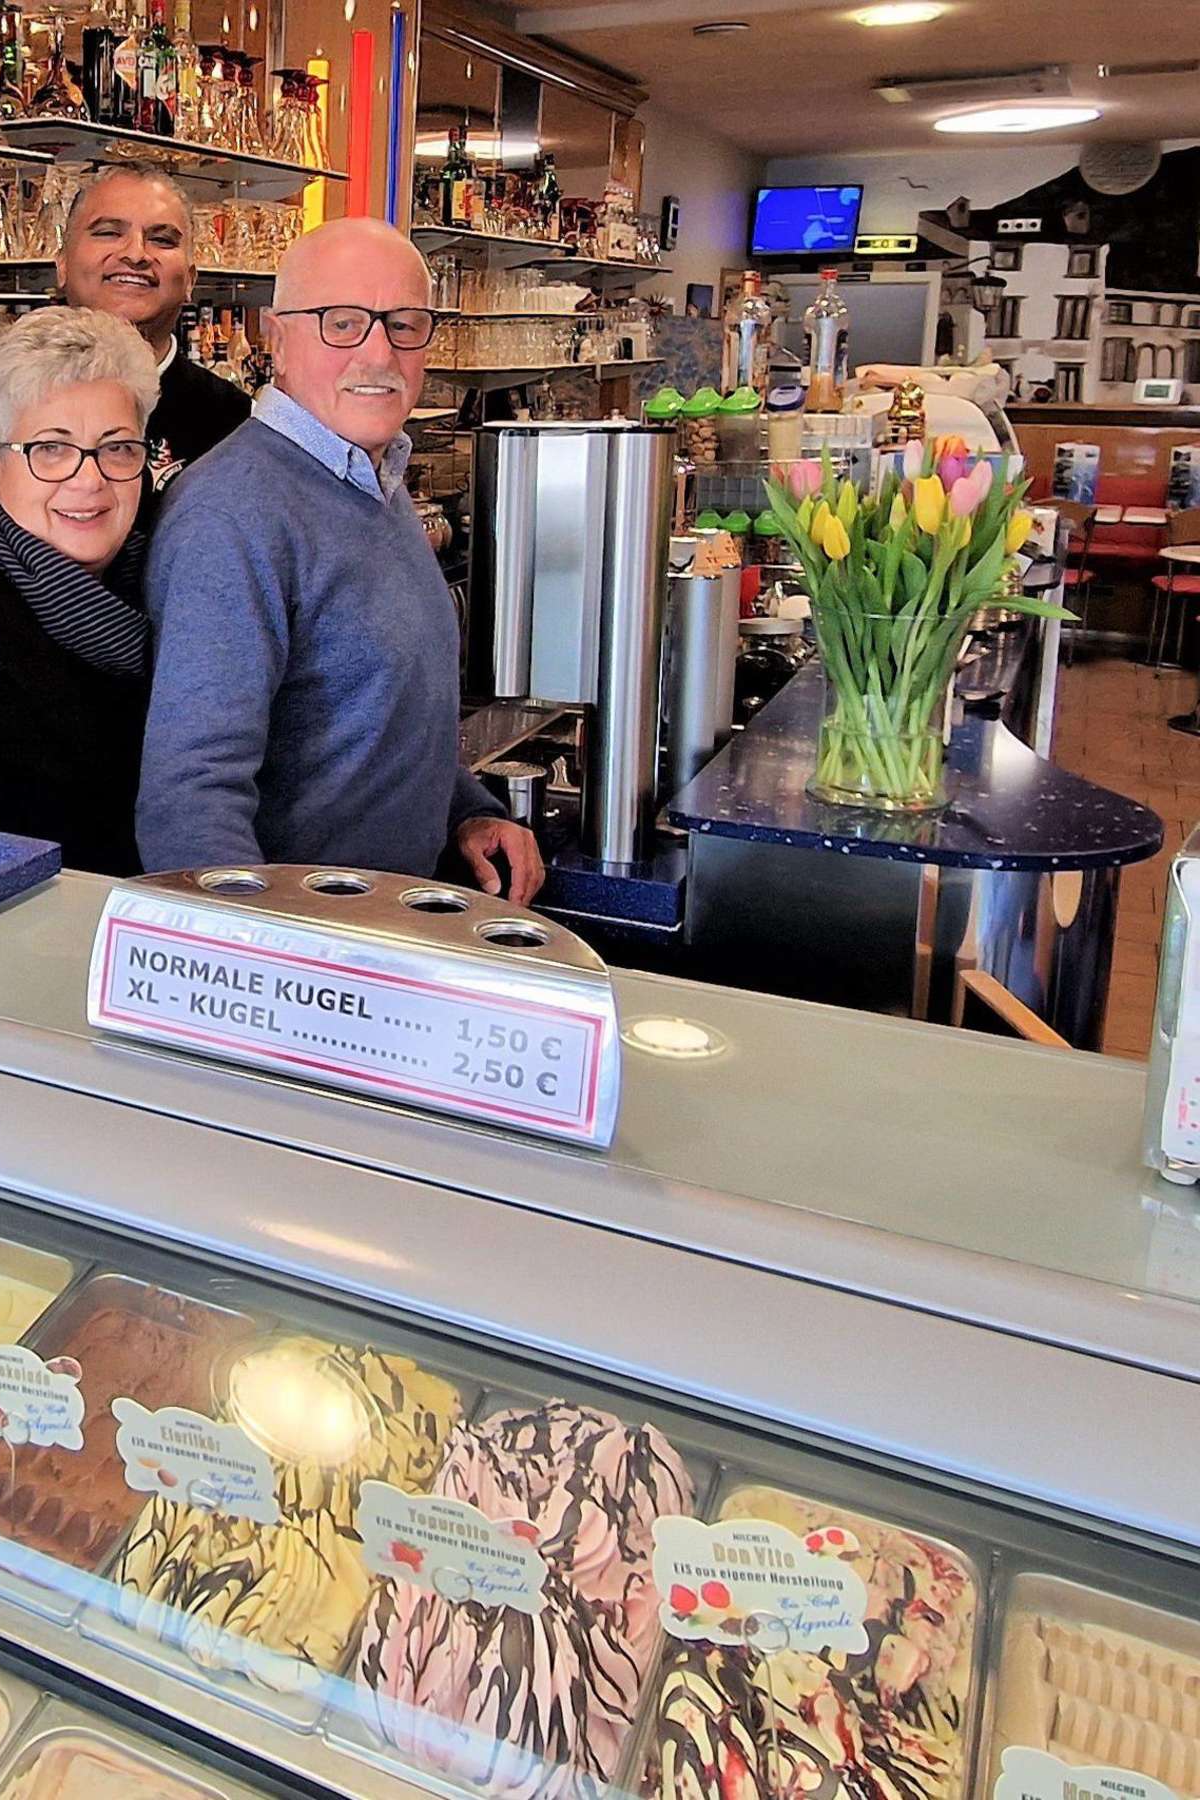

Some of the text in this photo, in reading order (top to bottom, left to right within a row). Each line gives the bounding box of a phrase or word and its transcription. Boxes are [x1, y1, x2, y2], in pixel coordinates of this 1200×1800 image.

[128, 945, 563, 1061] NORMALE KUGEL 1,50 €
[127, 978, 160, 1005] XL
[189, 993, 283, 1034] KUGEL
[451, 1051, 525, 1090] 2,50
[537, 1072, 559, 1097] €
[21, 1386, 69, 1403] Herstellung
[166, 1446, 201, 1461] eigener
[202, 1451, 257, 1474] Herstellung
[395, 1523, 414, 1536] aus
[416, 1527, 458, 1549] eigener
[461, 1541, 527, 1566] Herstellung
[712, 1541, 796, 1570] Don Vito
[694, 1565, 717, 1579] aus
[720, 1567, 767, 1583] eigener
[770, 1571, 844, 1591] Herstellung
[1100, 1778, 1146, 1798] MILCHEIS
